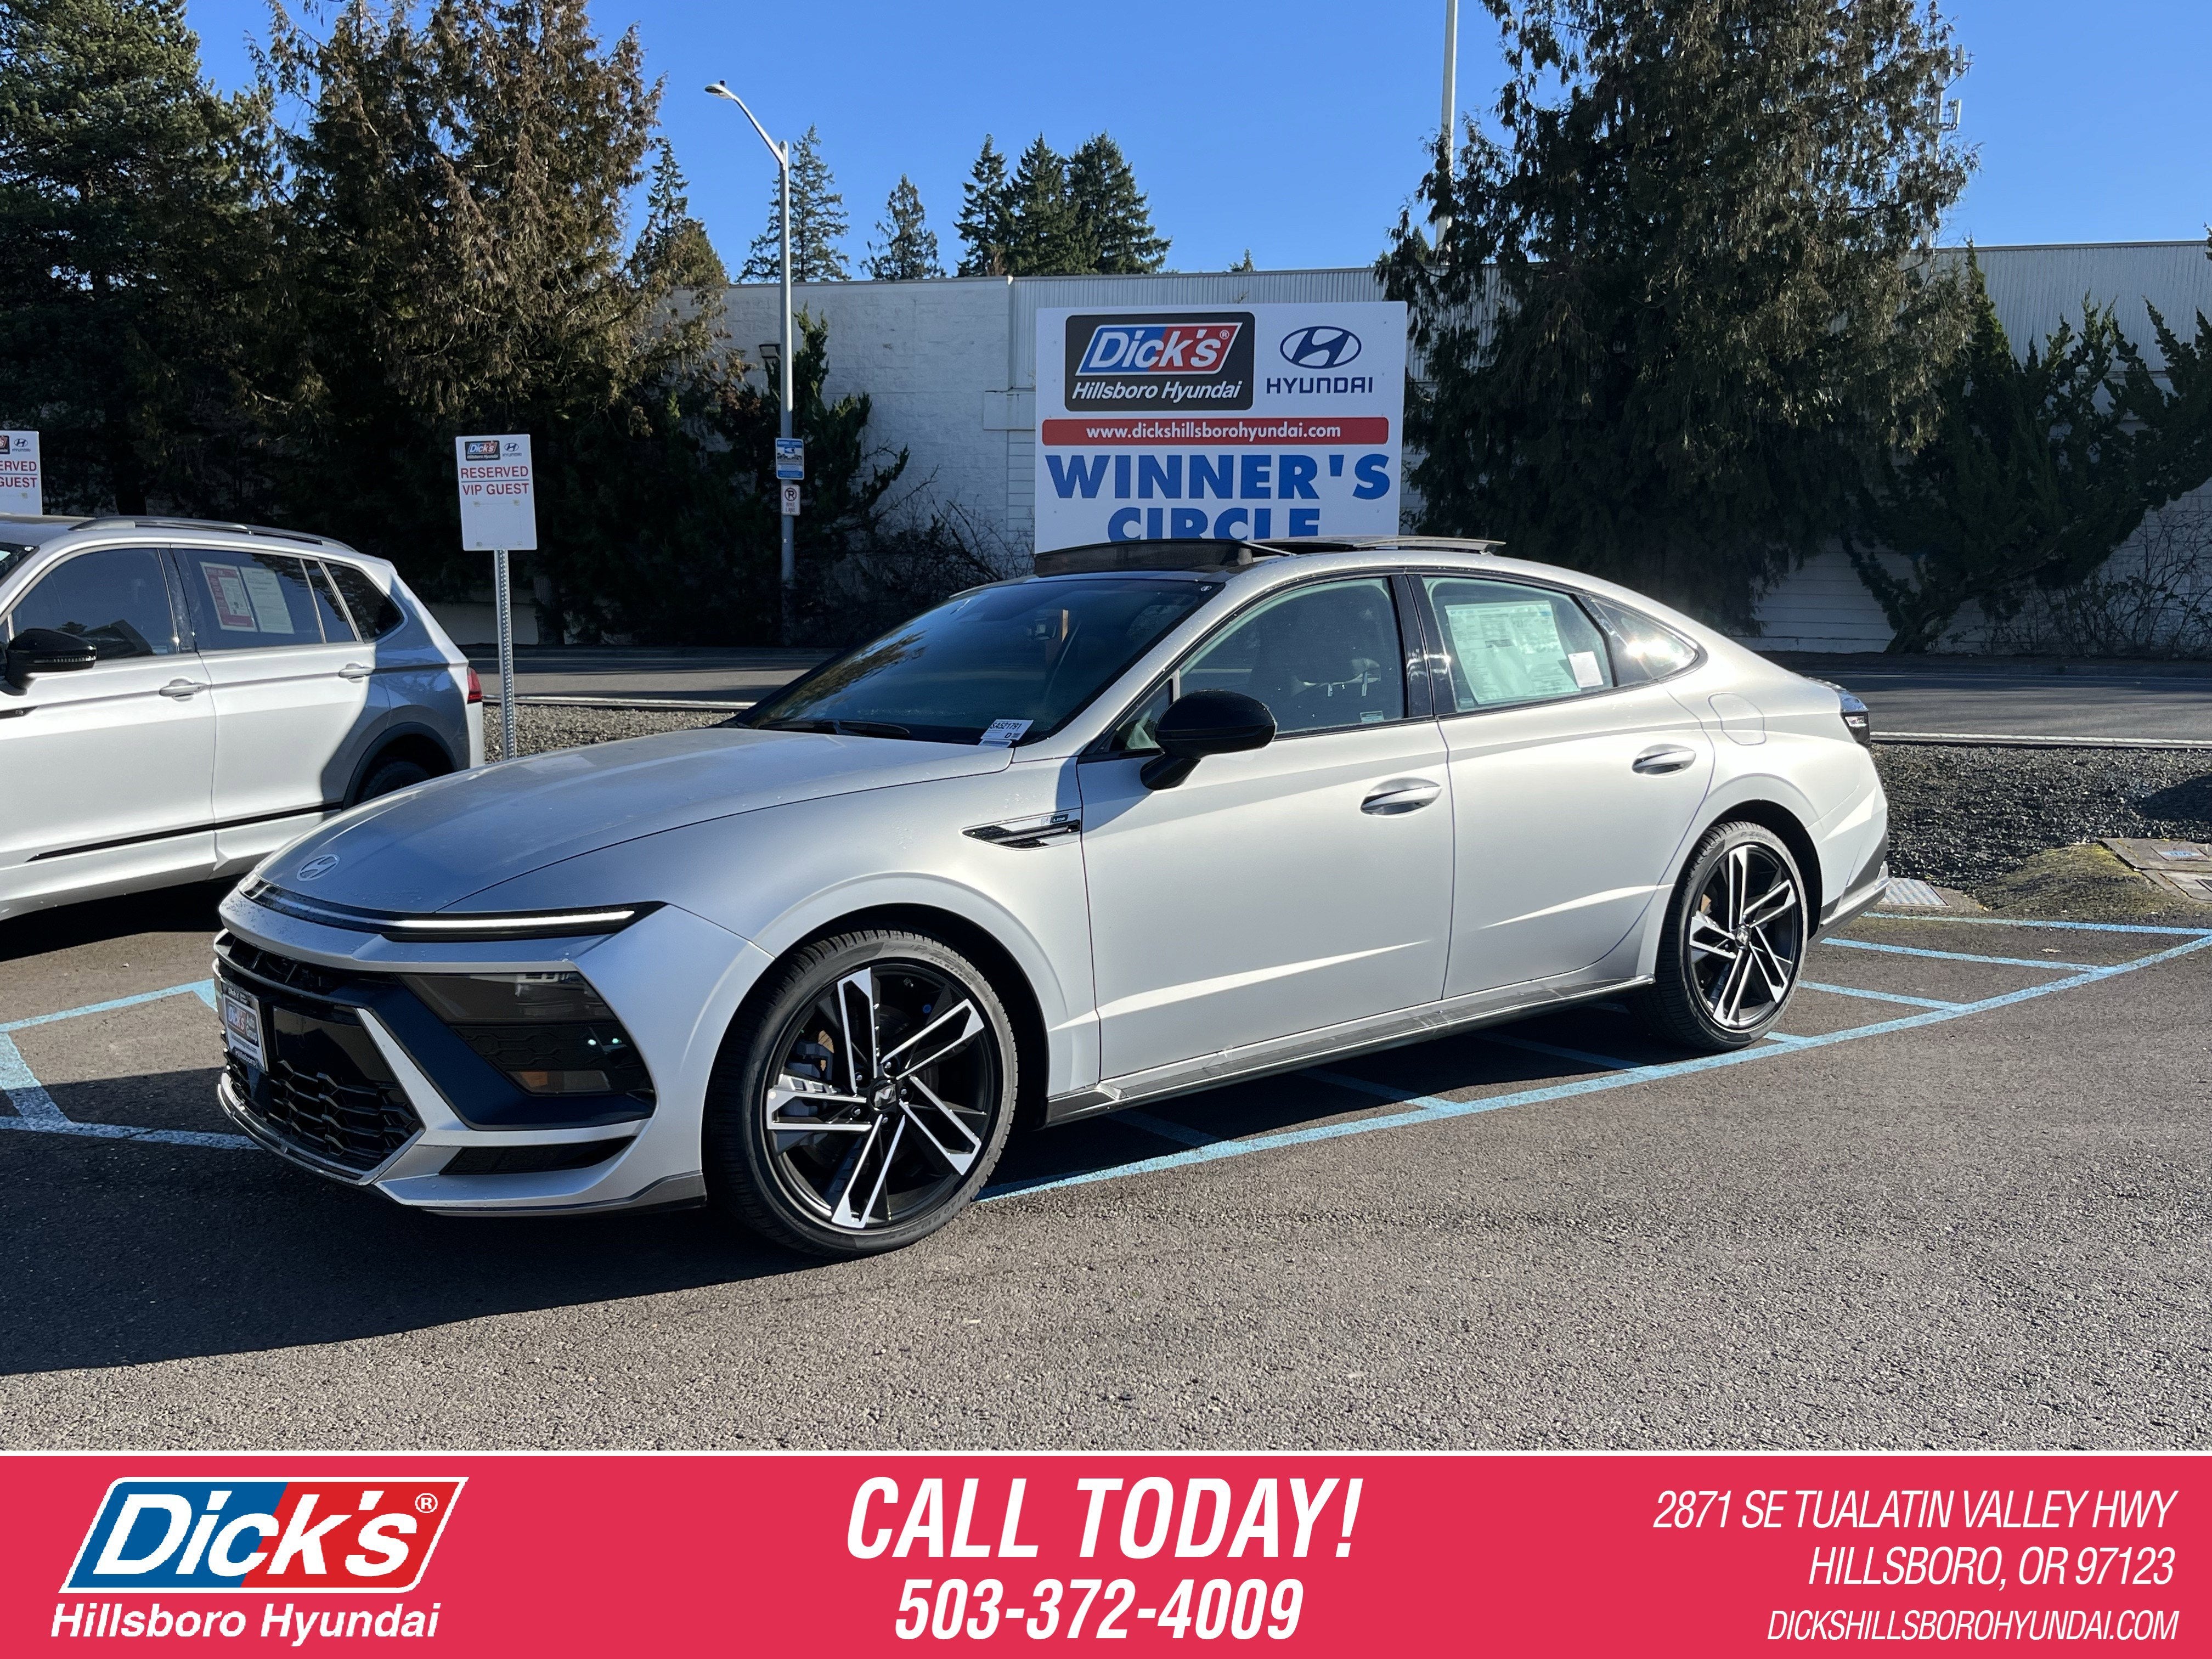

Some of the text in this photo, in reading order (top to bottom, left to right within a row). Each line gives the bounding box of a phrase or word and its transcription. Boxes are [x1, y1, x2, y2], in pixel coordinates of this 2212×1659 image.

[1071, 380, 1243, 403] Hillsboro Hyundai
[1266, 376, 1373, 395] HYUNDAI
[1086, 422, 1341, 442] www.dickshillsborohyundai.com
[460, 466, 529, 479] RESERVED
[1045, 453, 1390, 500] WINNER'S
[462, 483, 529, 495] VIP GUEST
